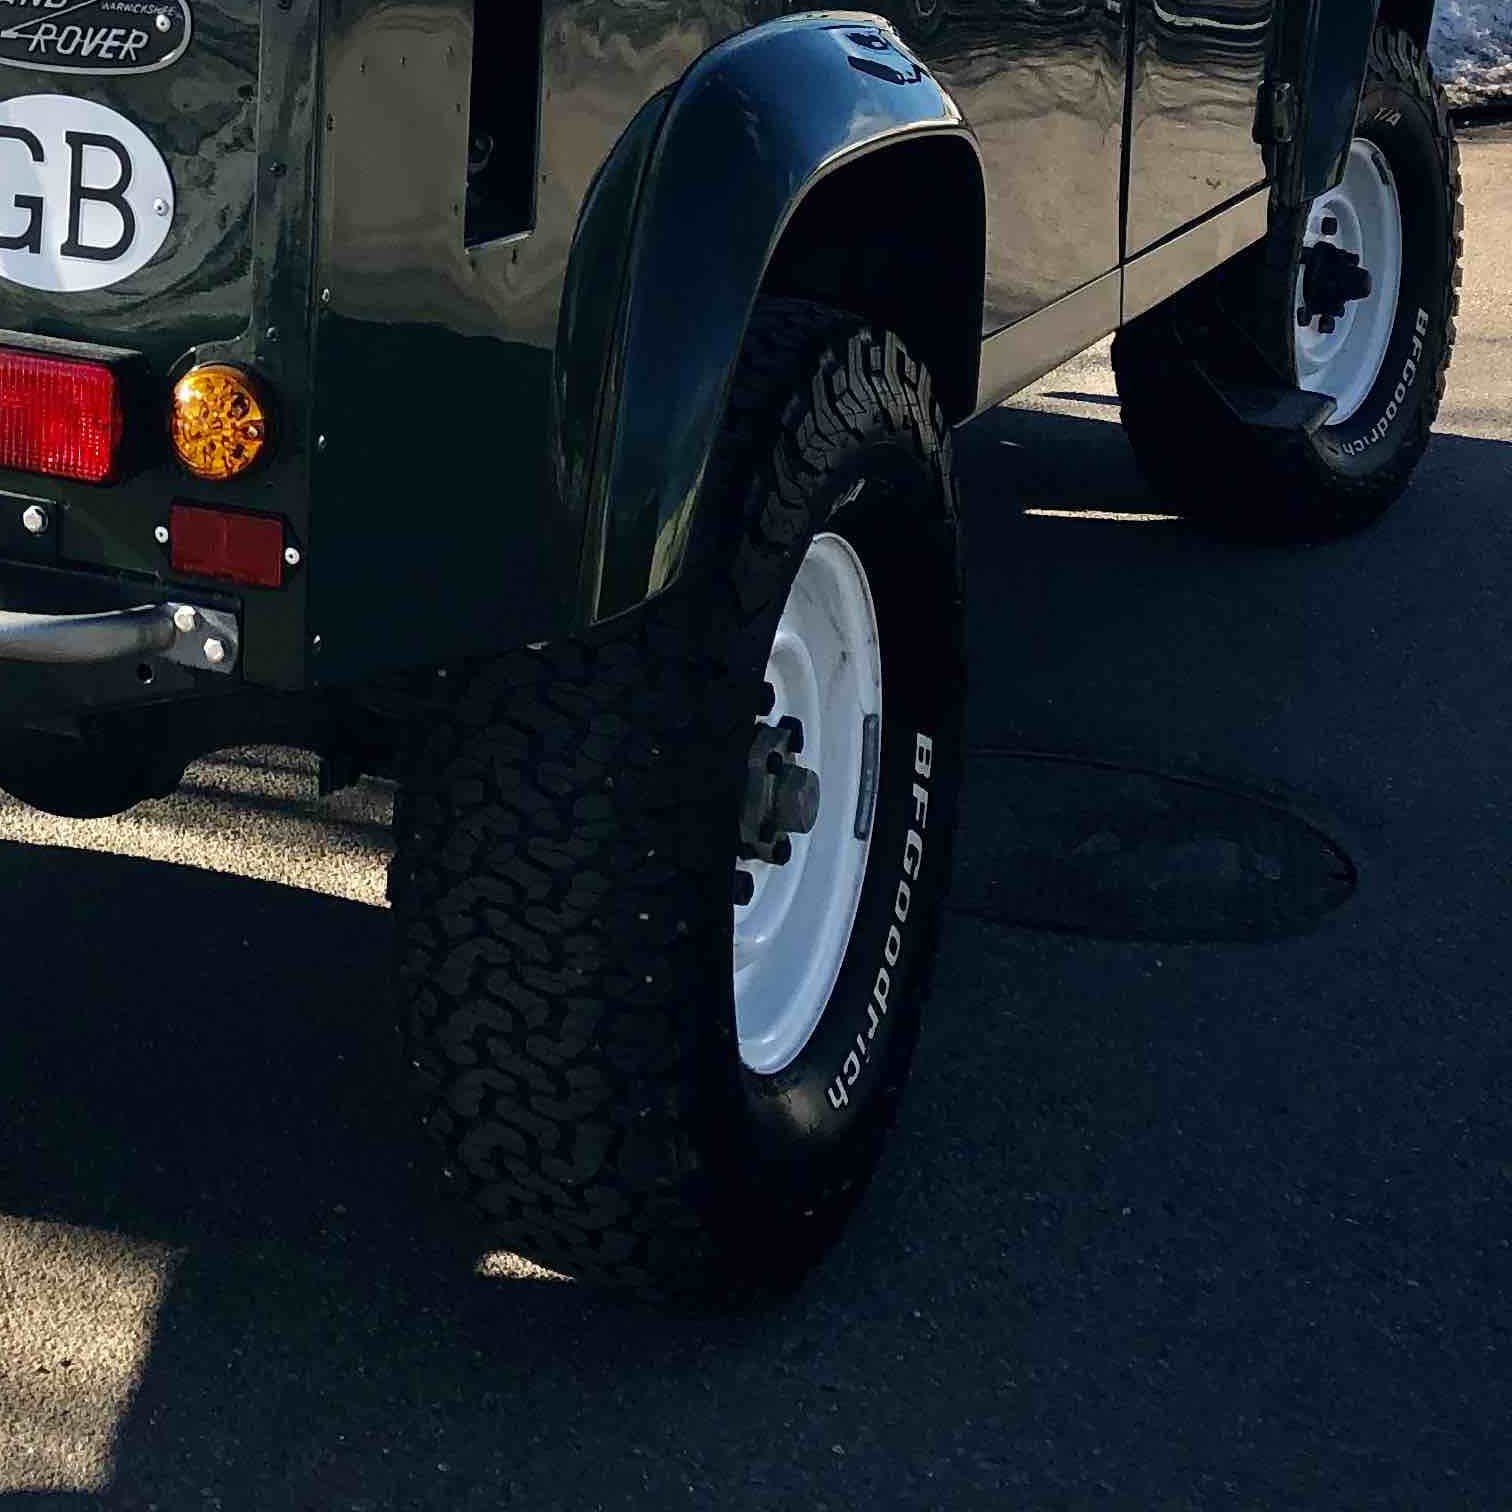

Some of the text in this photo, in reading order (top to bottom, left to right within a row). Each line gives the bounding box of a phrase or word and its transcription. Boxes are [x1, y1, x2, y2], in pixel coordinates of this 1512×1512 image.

[28, 22, 149, 61] ROVER
[1342, 306, 1430, 456] BFGoodrich
[828, 731, 934, 1112] BFGoodrich
